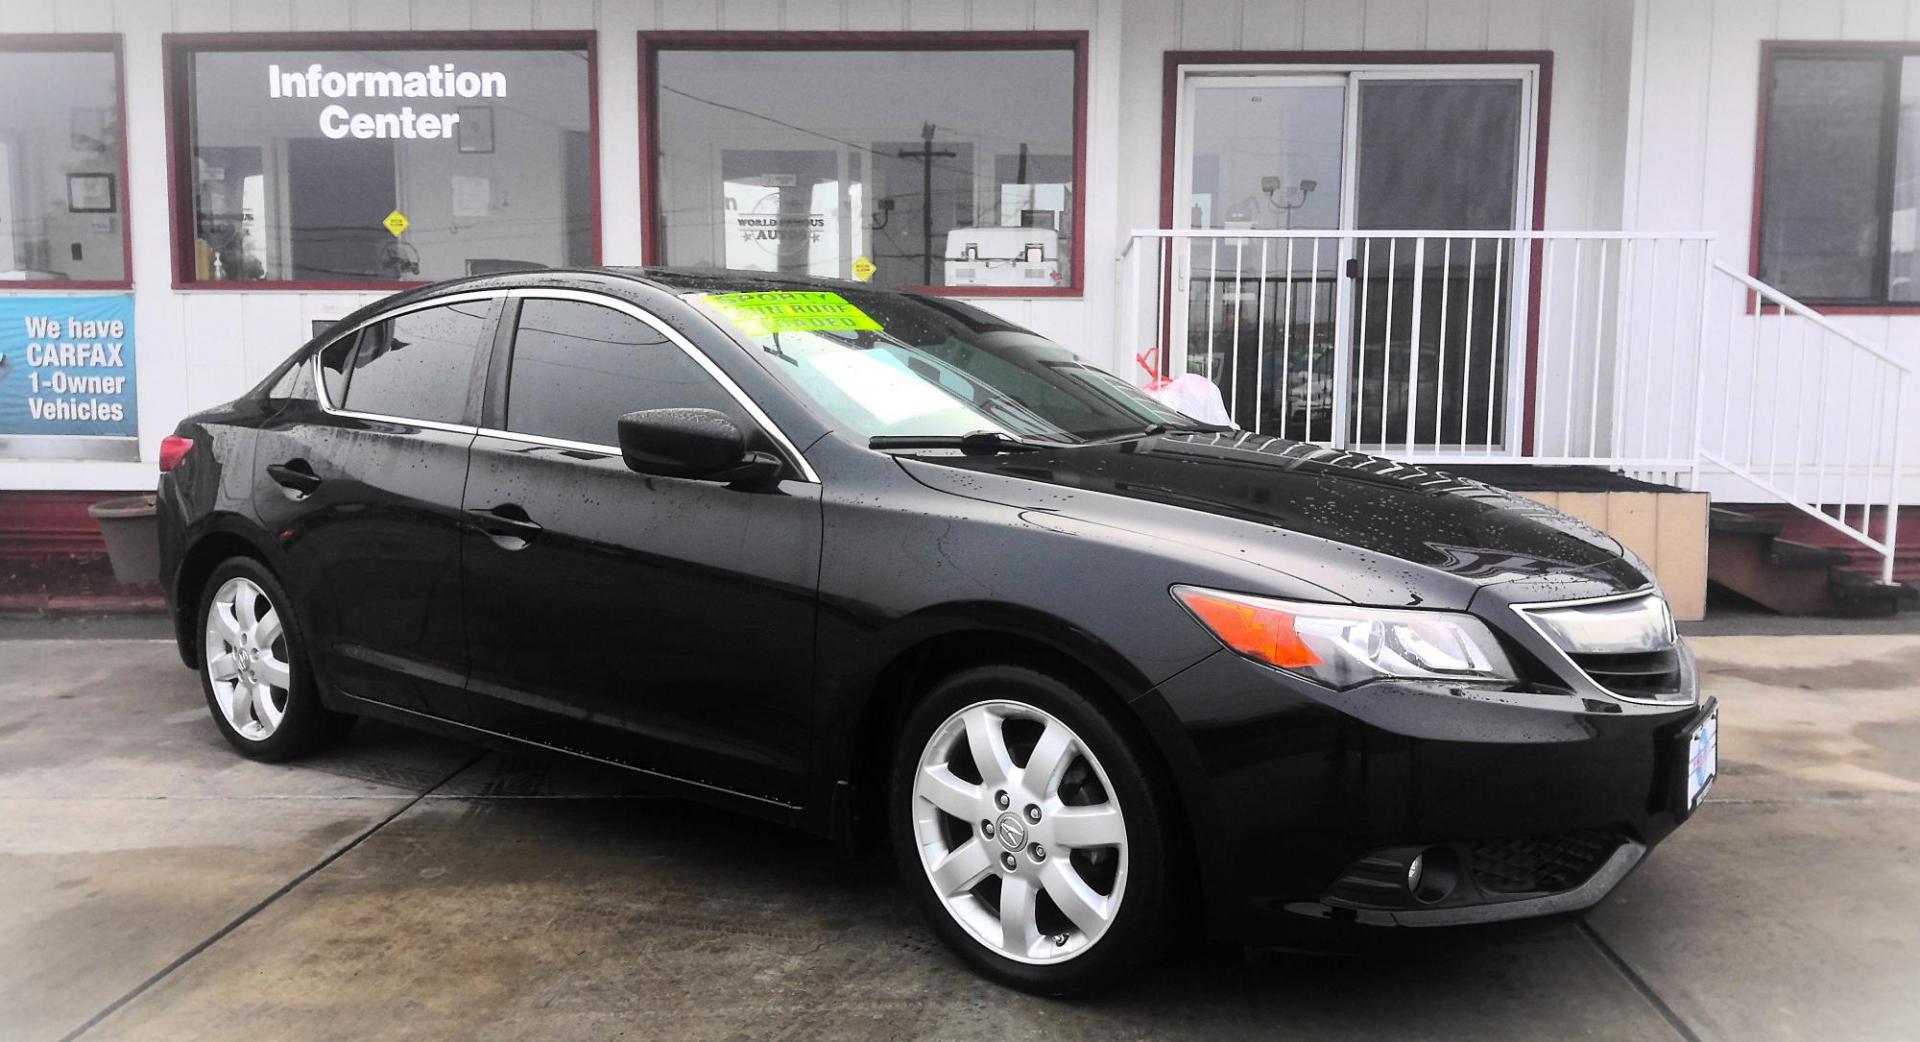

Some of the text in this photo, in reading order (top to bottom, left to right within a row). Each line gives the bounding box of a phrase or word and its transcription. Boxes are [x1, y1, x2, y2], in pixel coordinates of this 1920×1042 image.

[269, 64, 507, 97] Information
[319, 105, 460, 139] Center
[737, 218, 777, 227] WORLD
[790, 304, 850, 314] ROOF
[25, 316, 124, 339] We have
[26, 342, 124, 367] CARFAX
[29, 371, 126, 394] 1-Owner
[28, 397, 124, 421] Vehicles
